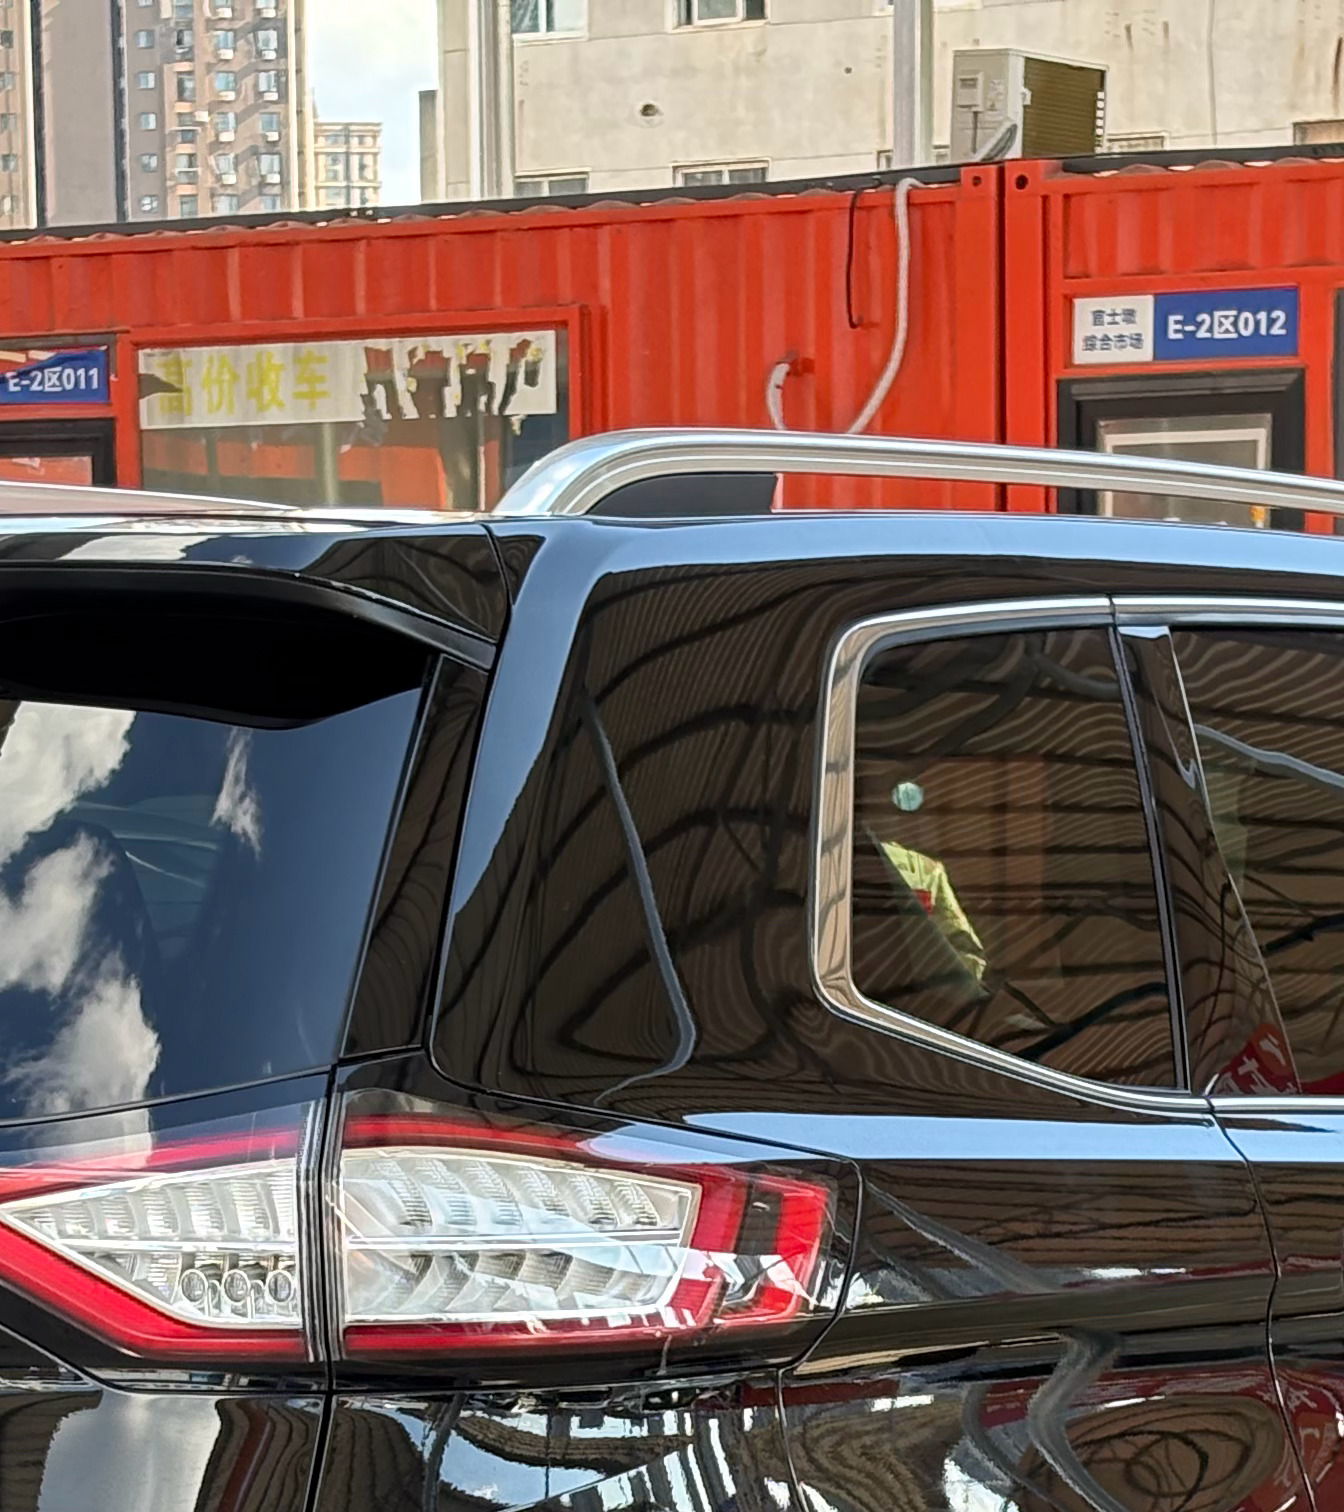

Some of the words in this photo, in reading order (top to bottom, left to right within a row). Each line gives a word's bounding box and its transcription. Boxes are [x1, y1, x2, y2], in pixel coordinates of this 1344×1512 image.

[1167, 310, 1288, 339] E-2区012
[6, 366, 99, 392] E-2区011
[156, 349, 330, 417] 高价收车
